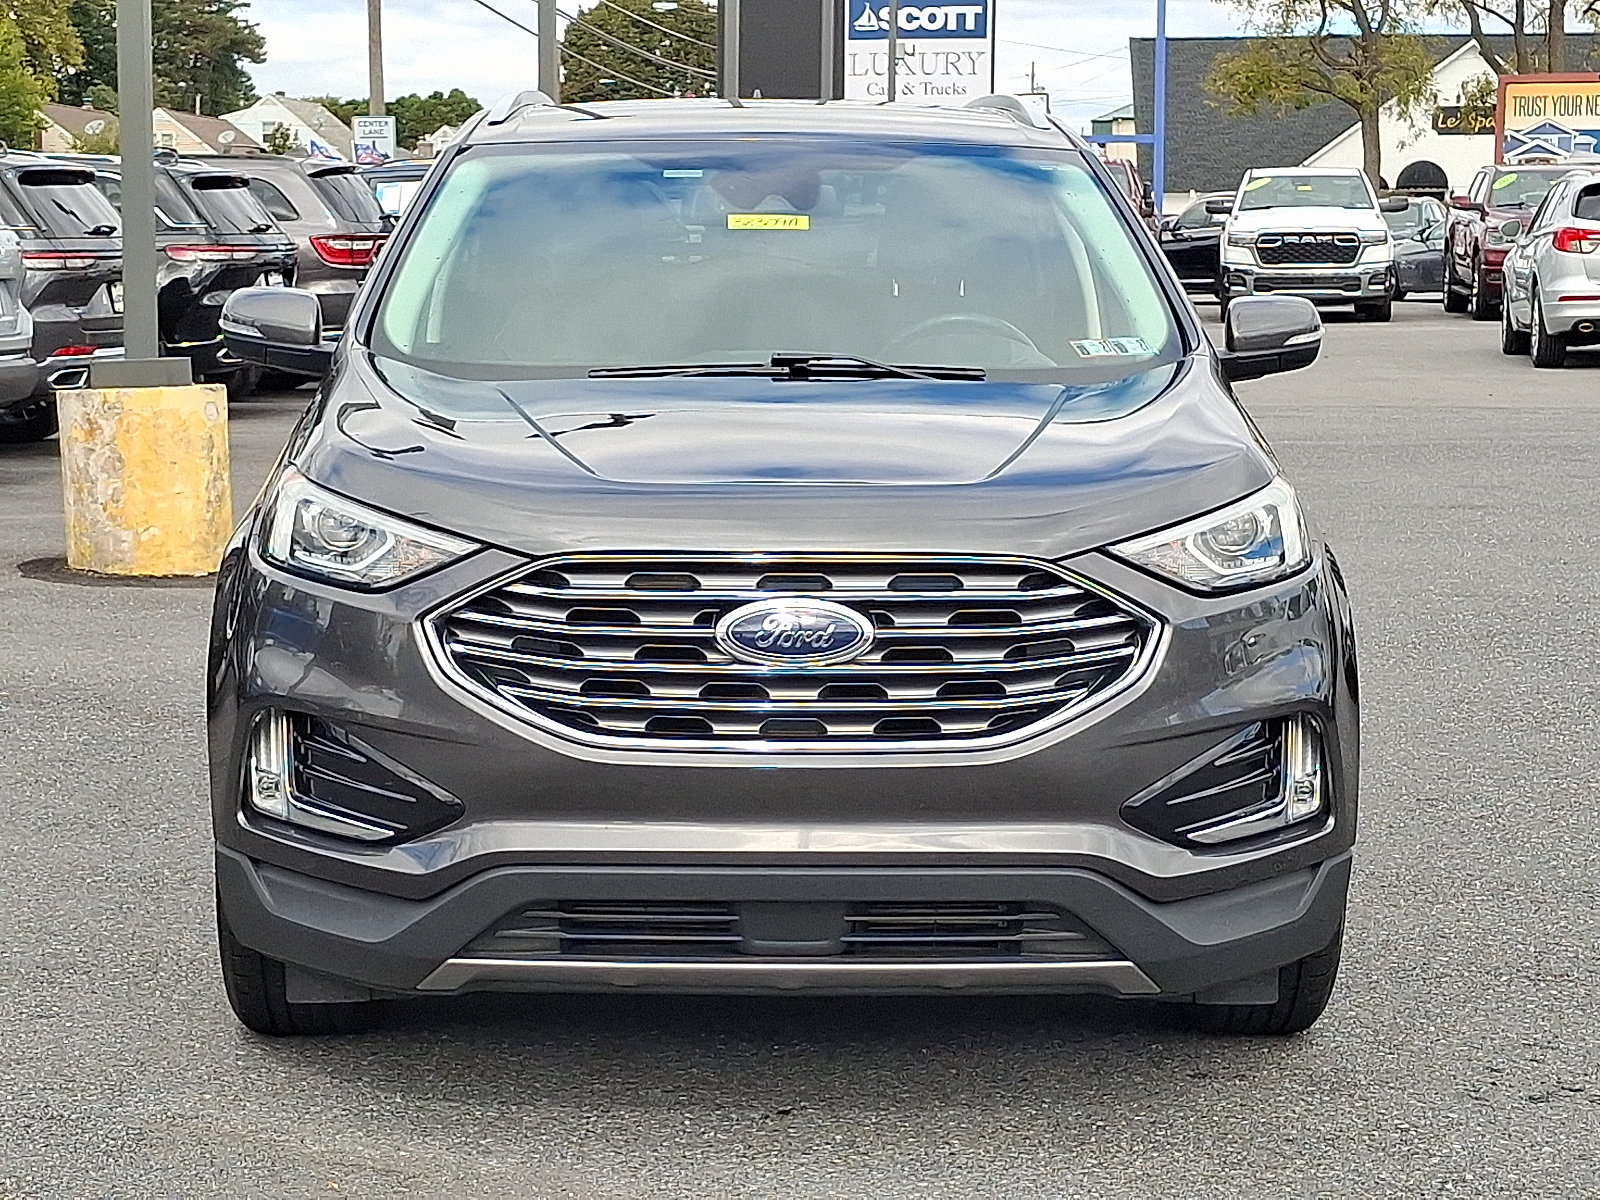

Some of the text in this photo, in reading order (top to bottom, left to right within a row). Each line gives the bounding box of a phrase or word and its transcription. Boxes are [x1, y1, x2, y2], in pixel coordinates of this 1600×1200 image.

[878, 5, 983, 31] SCOTT
[902, 82, 915, 95] &
[919, 81, 967, 96] Trucks
[1512, 95, 1547, 117] TRUST
[1550, 94, 1583, 117] YOUR
[358, 120, 389, 128] CENTER
[362, 128, 385, 136] LANE
[1283, 234, 1334, 244] RAM
[754, 612, 837, 648] Ford
